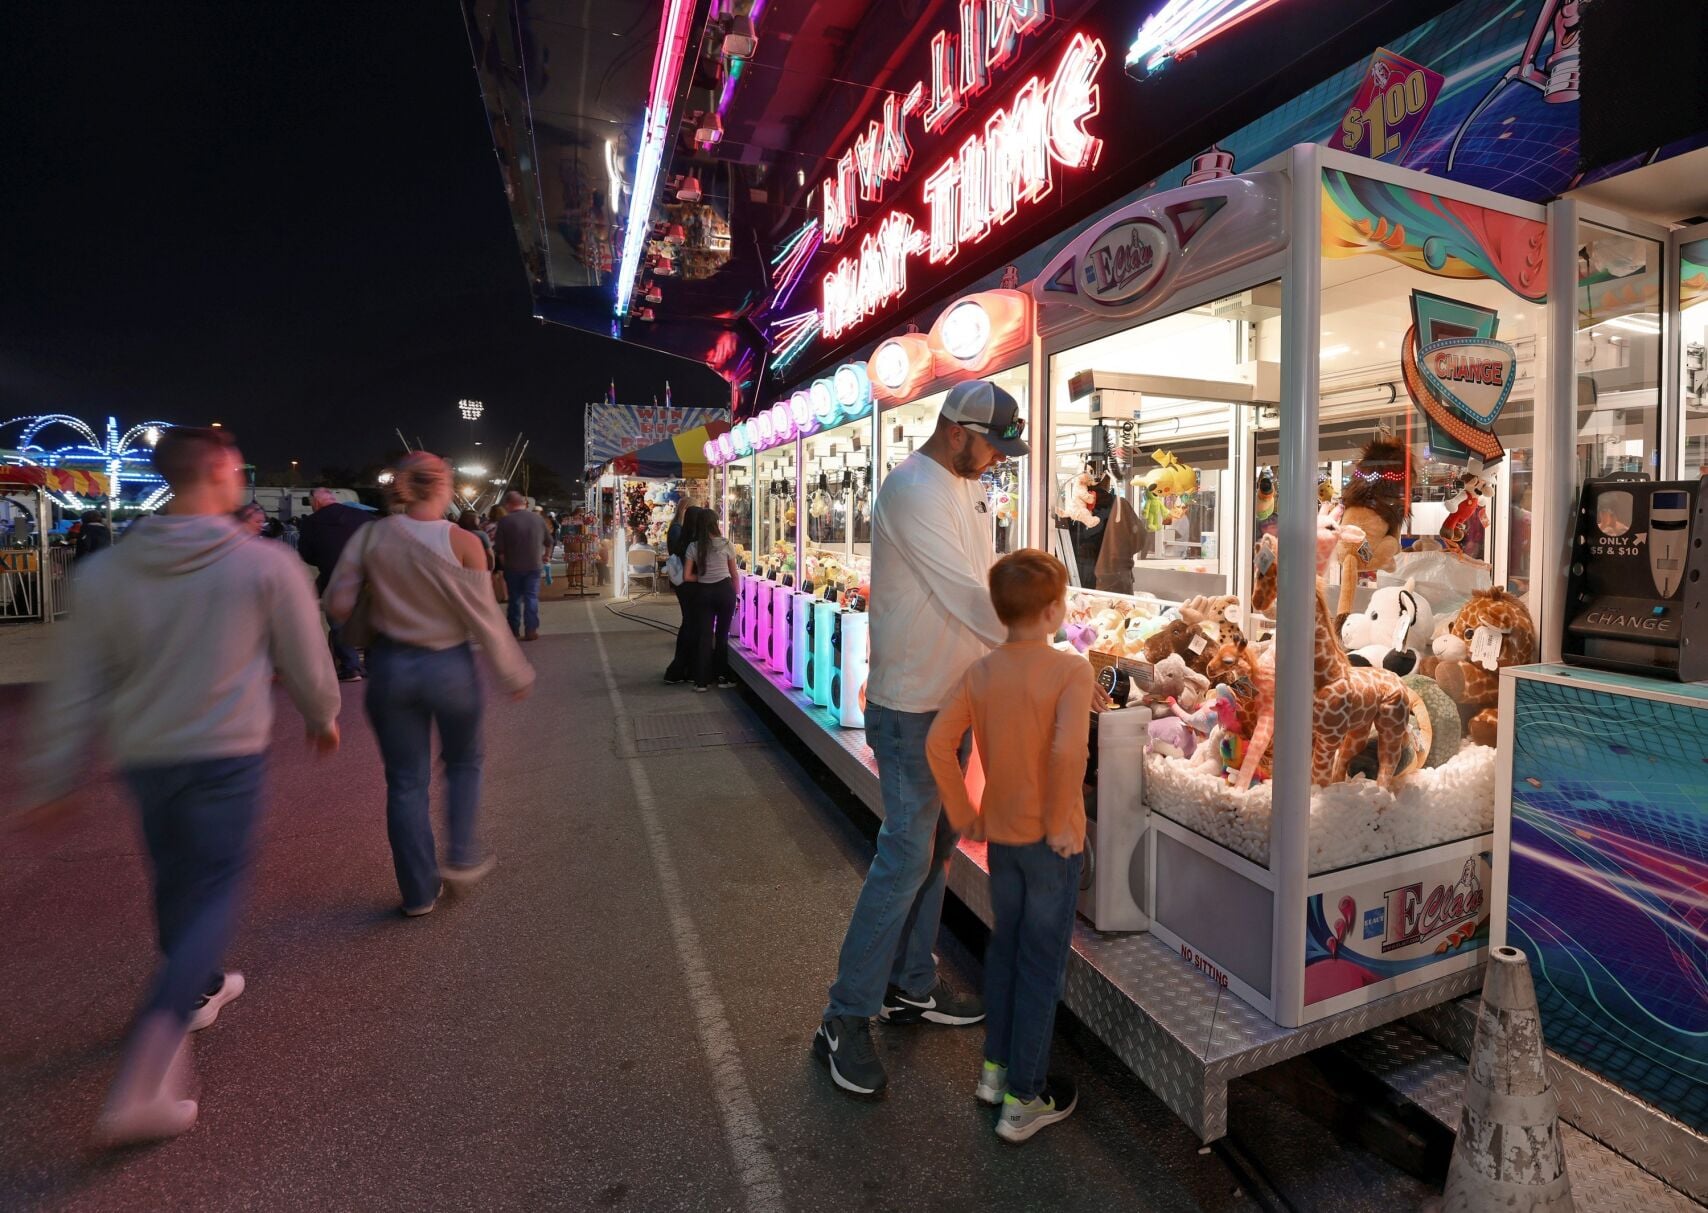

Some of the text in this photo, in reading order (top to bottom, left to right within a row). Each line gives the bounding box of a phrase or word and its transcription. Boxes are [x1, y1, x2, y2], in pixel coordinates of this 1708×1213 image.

[1342, 69, 1428, 160] $1.00
[822, 32, 1106, 339] PLAY-TIME
[1434, 352, 1503, 387] CHANGE
[636, 408, 683, 420] WIN
[640, 422, 681, 435] BIG
[1590, 546, 1639, 556] $5 & $10
[1599, 537, 1629, 545] ONLY
[1586, 612, 1672, 632] CHANGE
[1181, 944, 1228, 988] NO SITTING
